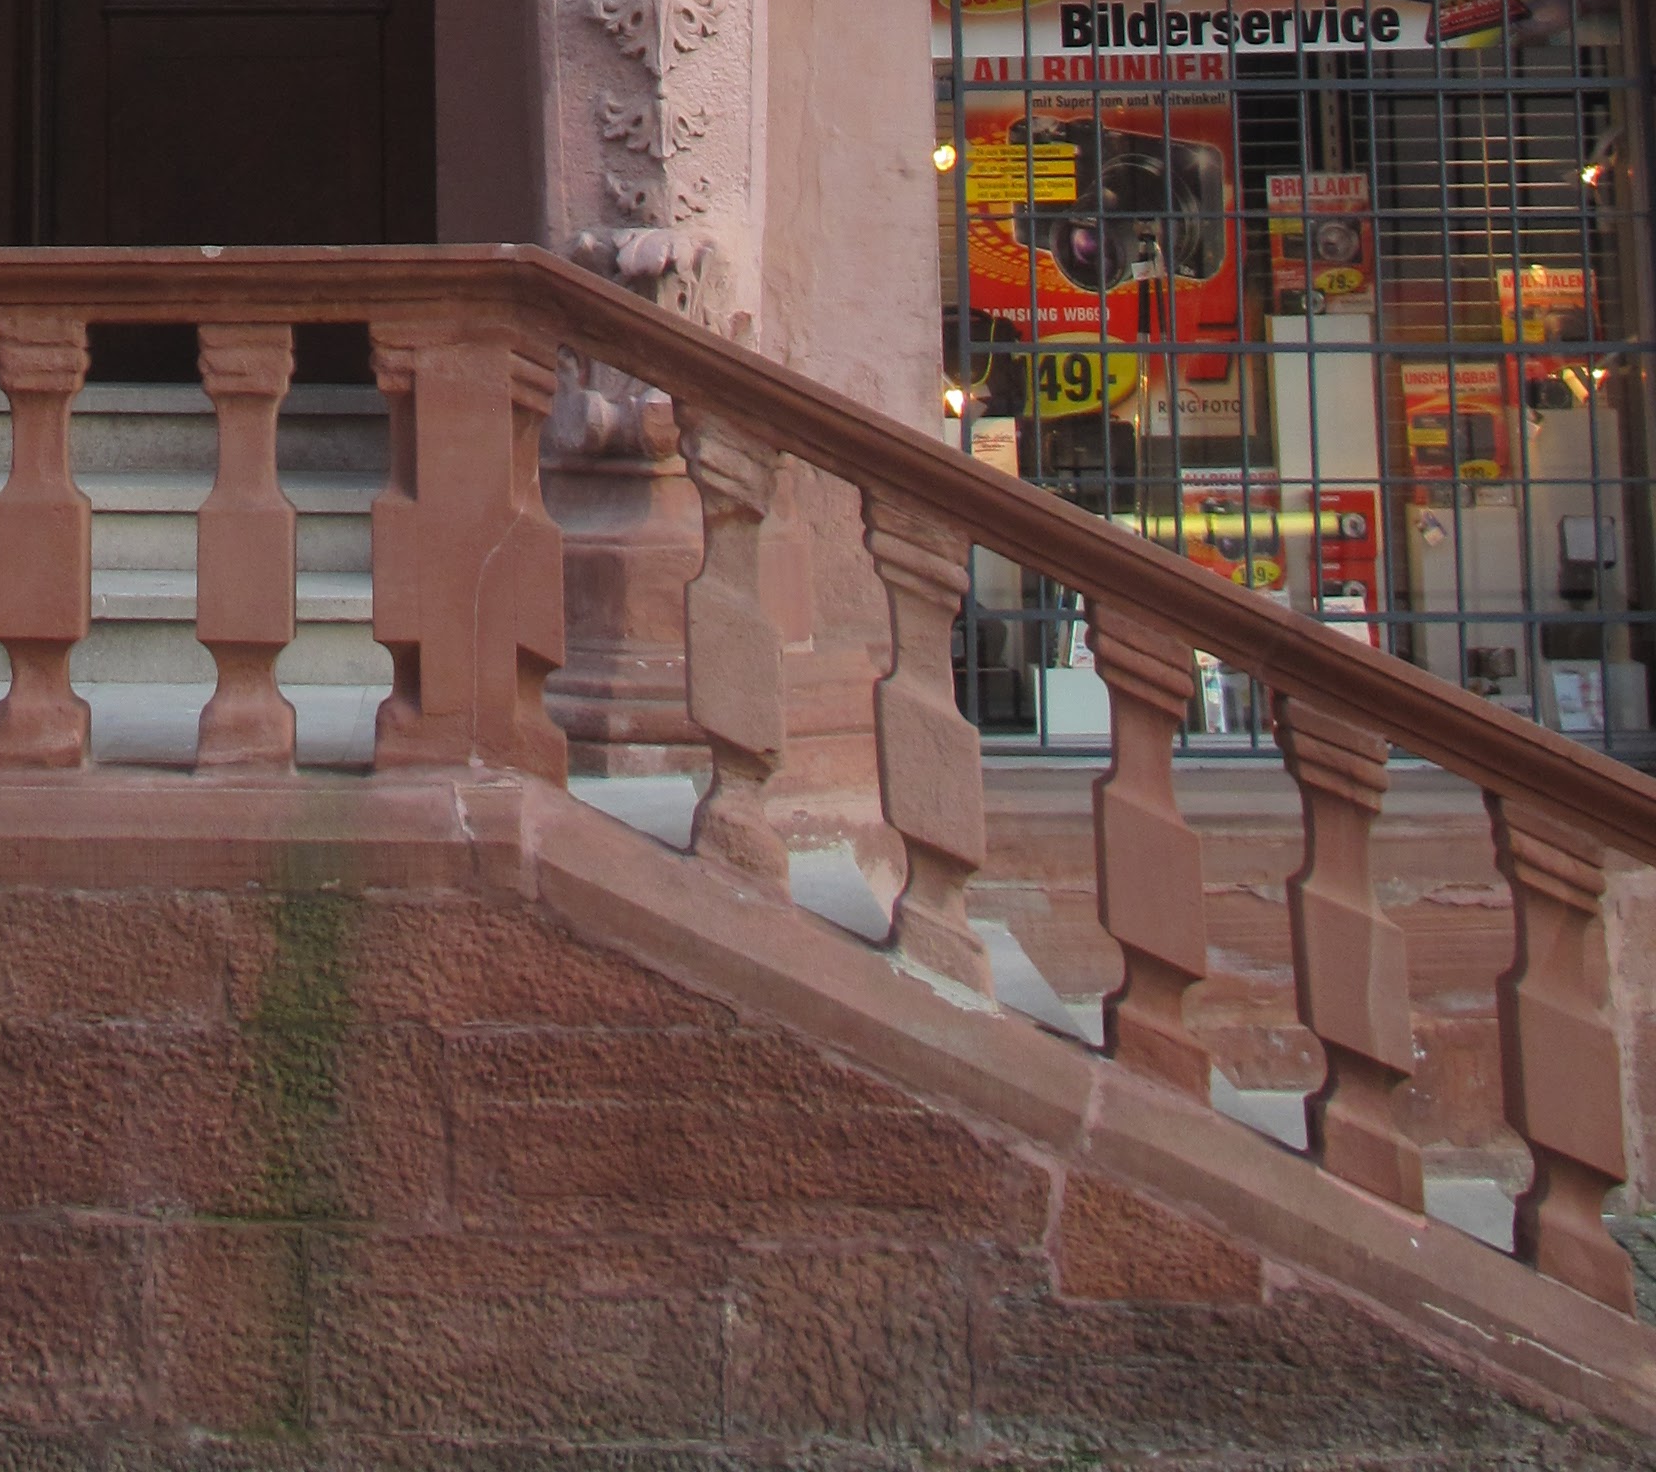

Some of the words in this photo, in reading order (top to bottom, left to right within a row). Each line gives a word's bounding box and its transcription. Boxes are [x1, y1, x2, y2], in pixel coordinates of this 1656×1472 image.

[972, 54, 1225, 81] ALROUNDER
[1032, 96, 1052, 108] mit
[1127, 92, 1149, 107] und
[1271, 177, 1363, 197] BRILANT
[1404, 371, 1497, 385] UNSCHAGBAR
[1158, 400, 1198, 414] RNG
